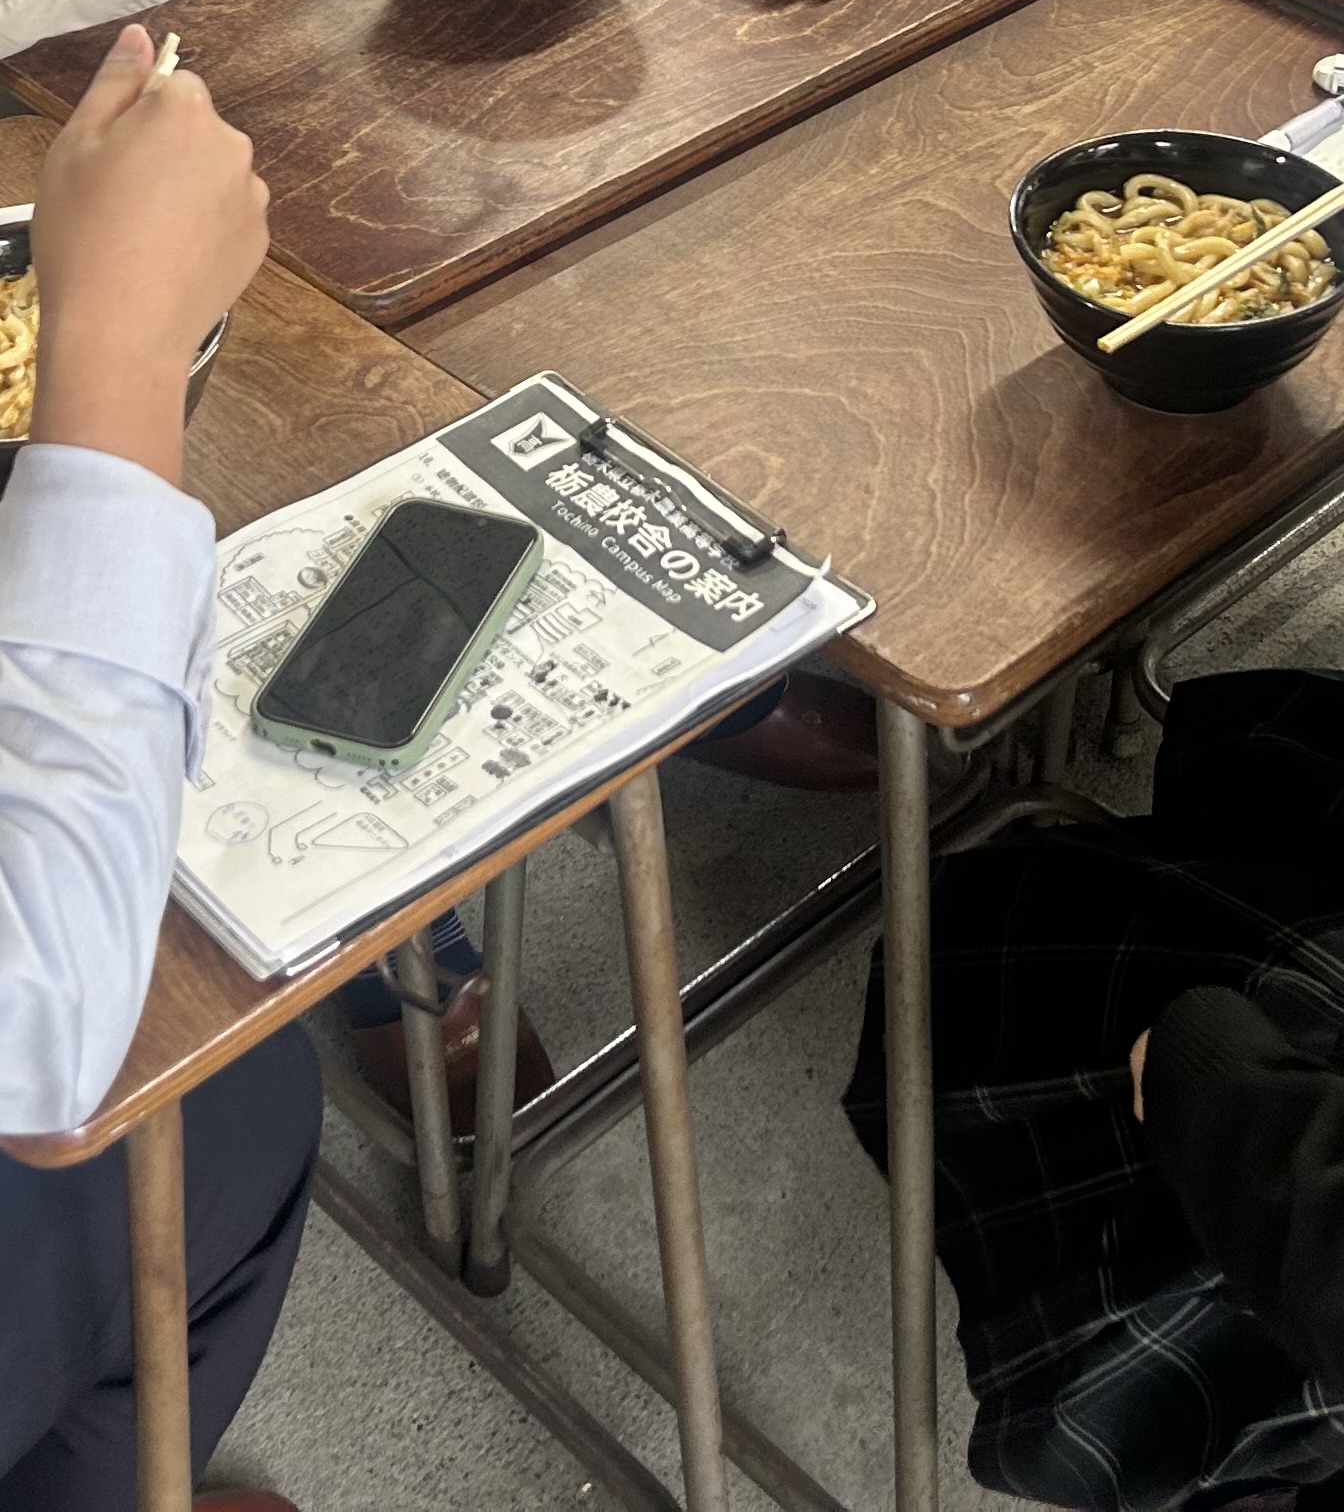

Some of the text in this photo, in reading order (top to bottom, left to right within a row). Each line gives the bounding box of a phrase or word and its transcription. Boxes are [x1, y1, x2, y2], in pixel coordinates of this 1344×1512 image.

[544, 462, 765, 623] 栃農校舎の案内
[601, 536, 654, 589] Campus
[652, 575, 682, 604] Map
